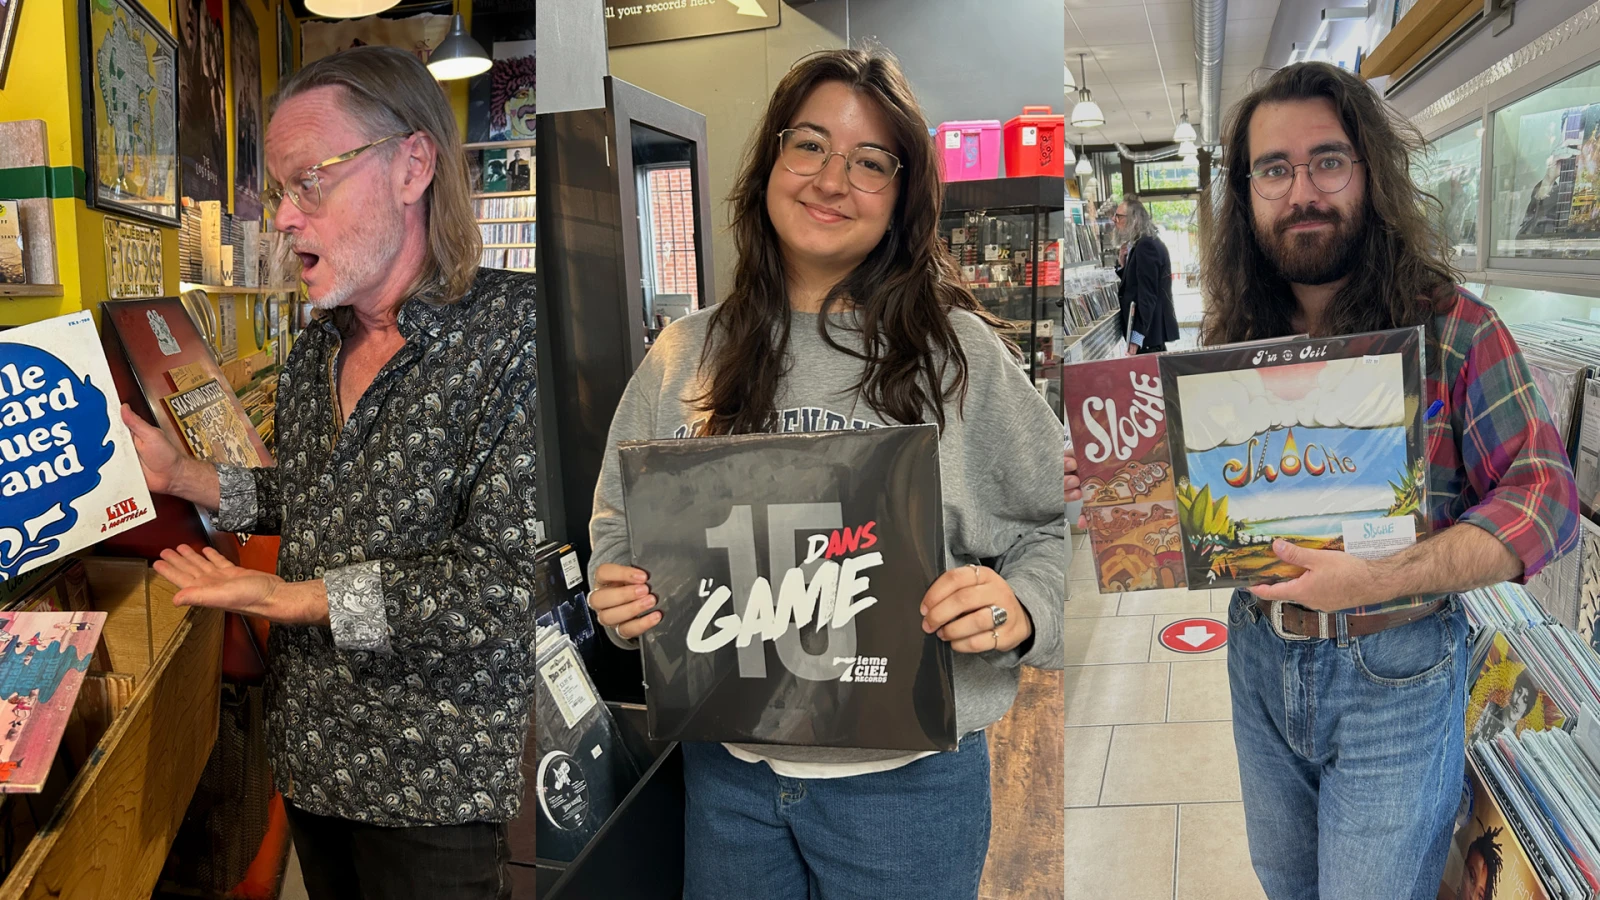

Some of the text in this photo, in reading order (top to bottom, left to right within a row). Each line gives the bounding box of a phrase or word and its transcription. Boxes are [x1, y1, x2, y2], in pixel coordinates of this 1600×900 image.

[604, 6, 616, 18] ll
[617, 5, 643, 19] your
[645, 0, 687, 13] records
[0, 378, 79, 430] ard
[0, 421, 72, 464] ues
[804, 521, 878, 564] DANS
[686, 552, 884, 654] GAME
[706, 502, 858, 681] 15
[854, 664, 889, 677] CIEL
[854, 676, 888, 684] RECORDS
